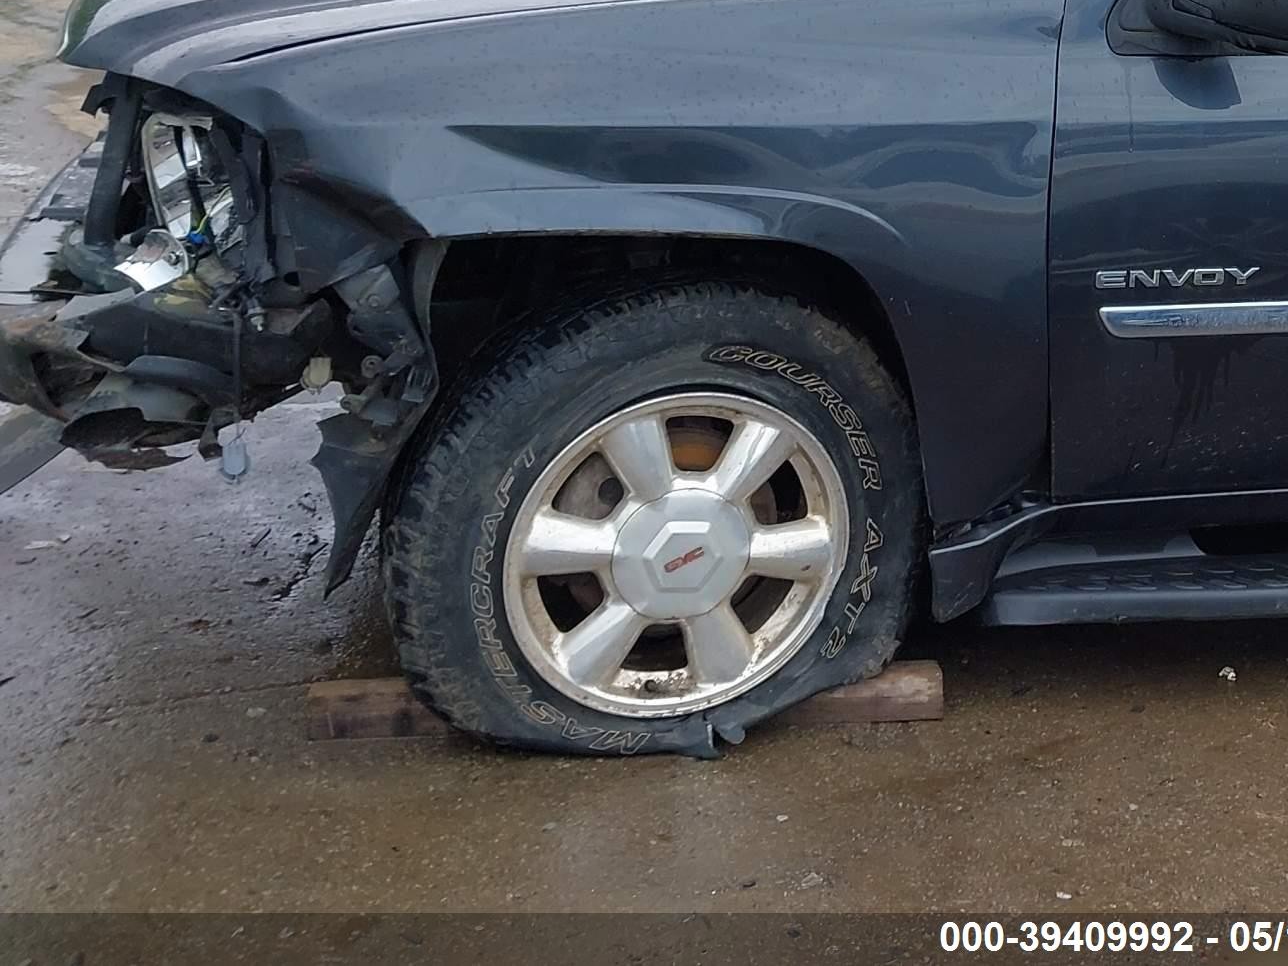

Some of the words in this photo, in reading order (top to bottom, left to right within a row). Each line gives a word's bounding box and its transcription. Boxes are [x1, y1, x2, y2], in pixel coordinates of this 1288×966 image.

[1096, 267, 1260, 289] ENVOY
[470, 446, 651, 755] MASTERCRAFT
[709, 344, 883, 491] COURSER
[820, 517, 884, 660] AXT2
